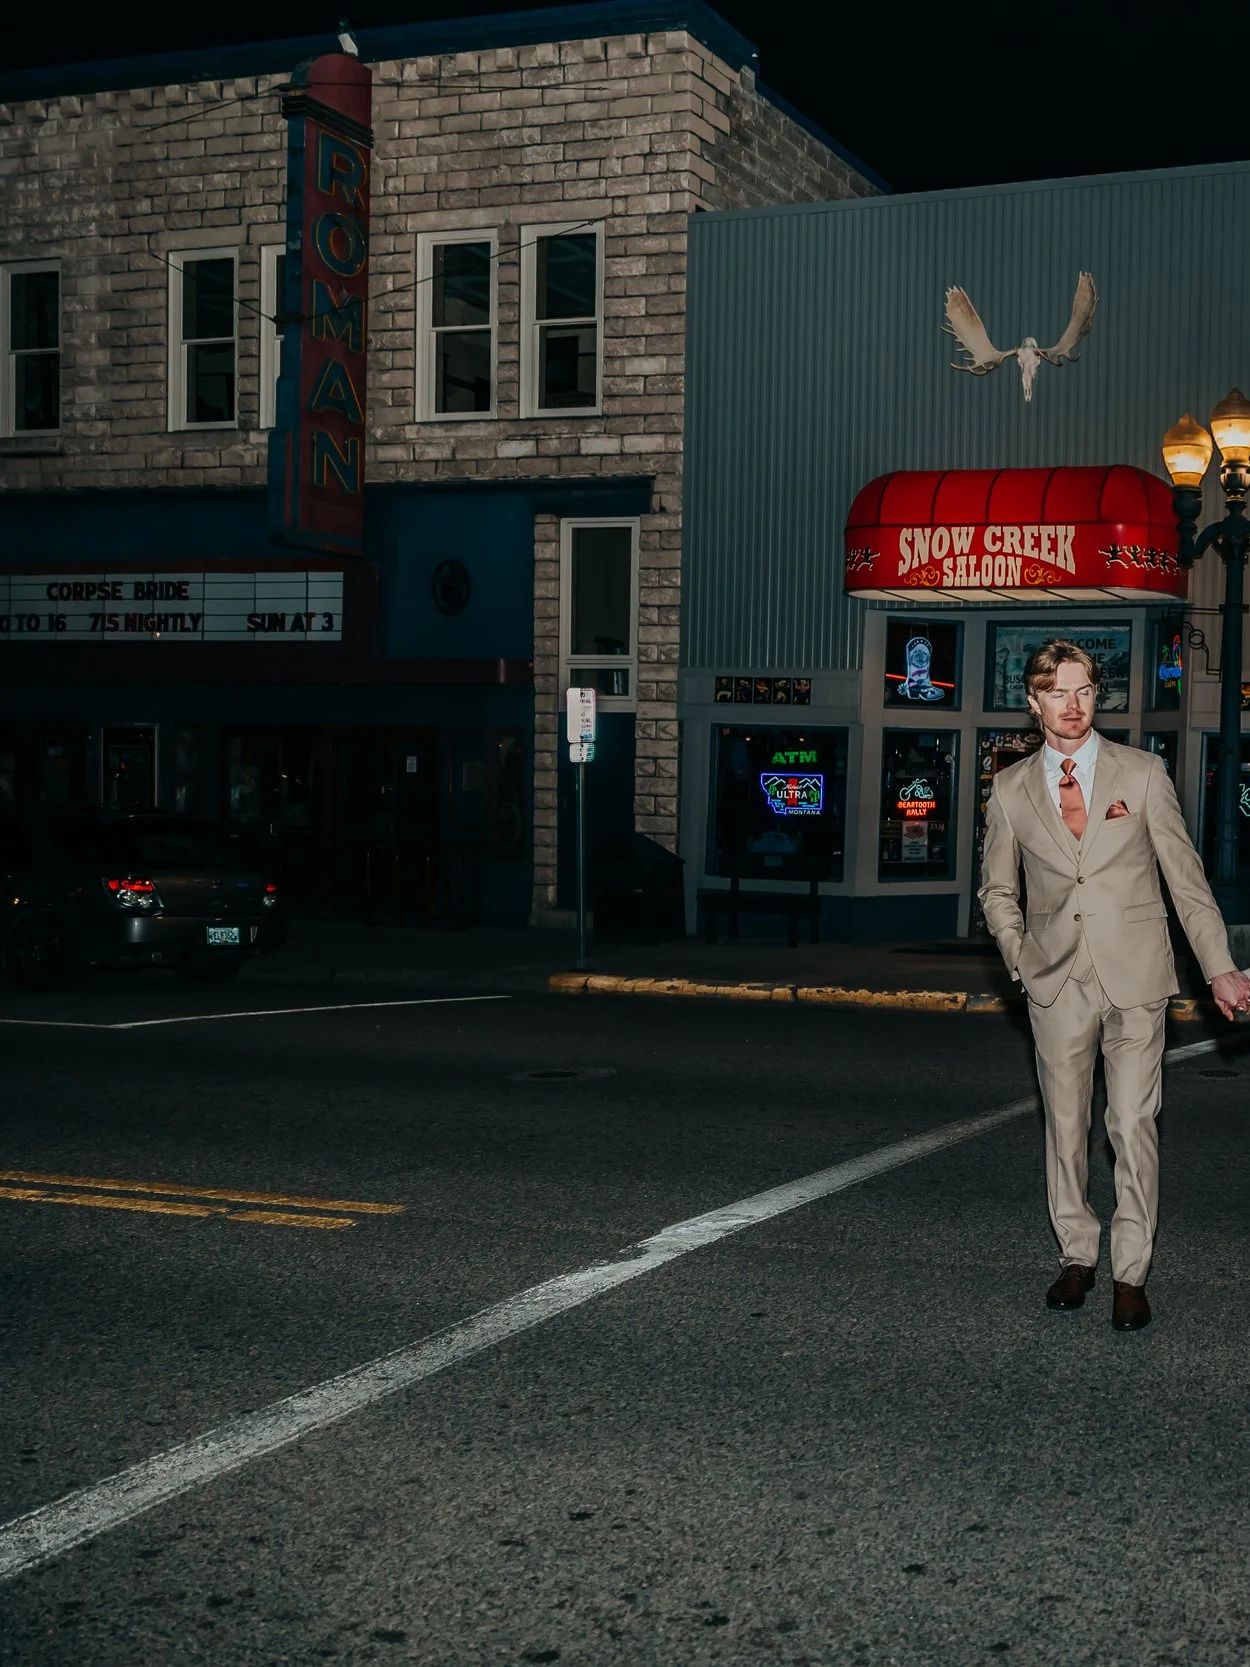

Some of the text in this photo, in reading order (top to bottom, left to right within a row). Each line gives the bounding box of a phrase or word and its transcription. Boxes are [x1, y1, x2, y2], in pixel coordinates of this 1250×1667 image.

[309, 128, 367, 496] ROMAN
[898, 525, 1075, 576] SNOW CREEK
[942, 554, 1022, 587] SALOON
[46, 581, 189, 600] CORPSE BRIDE
[15, 613, 40, 632] TO
[48, 613, 66, 632] 16
[124, 613, 202, 632] NIGHTLY
[247, 612, 285, 632] SUN
[289, 612, 316, 632] AT
[322, 612, 334, 632] 3
[771, 751, 817, 764] ATM
[776, 790, 807, 799] ULTRA
